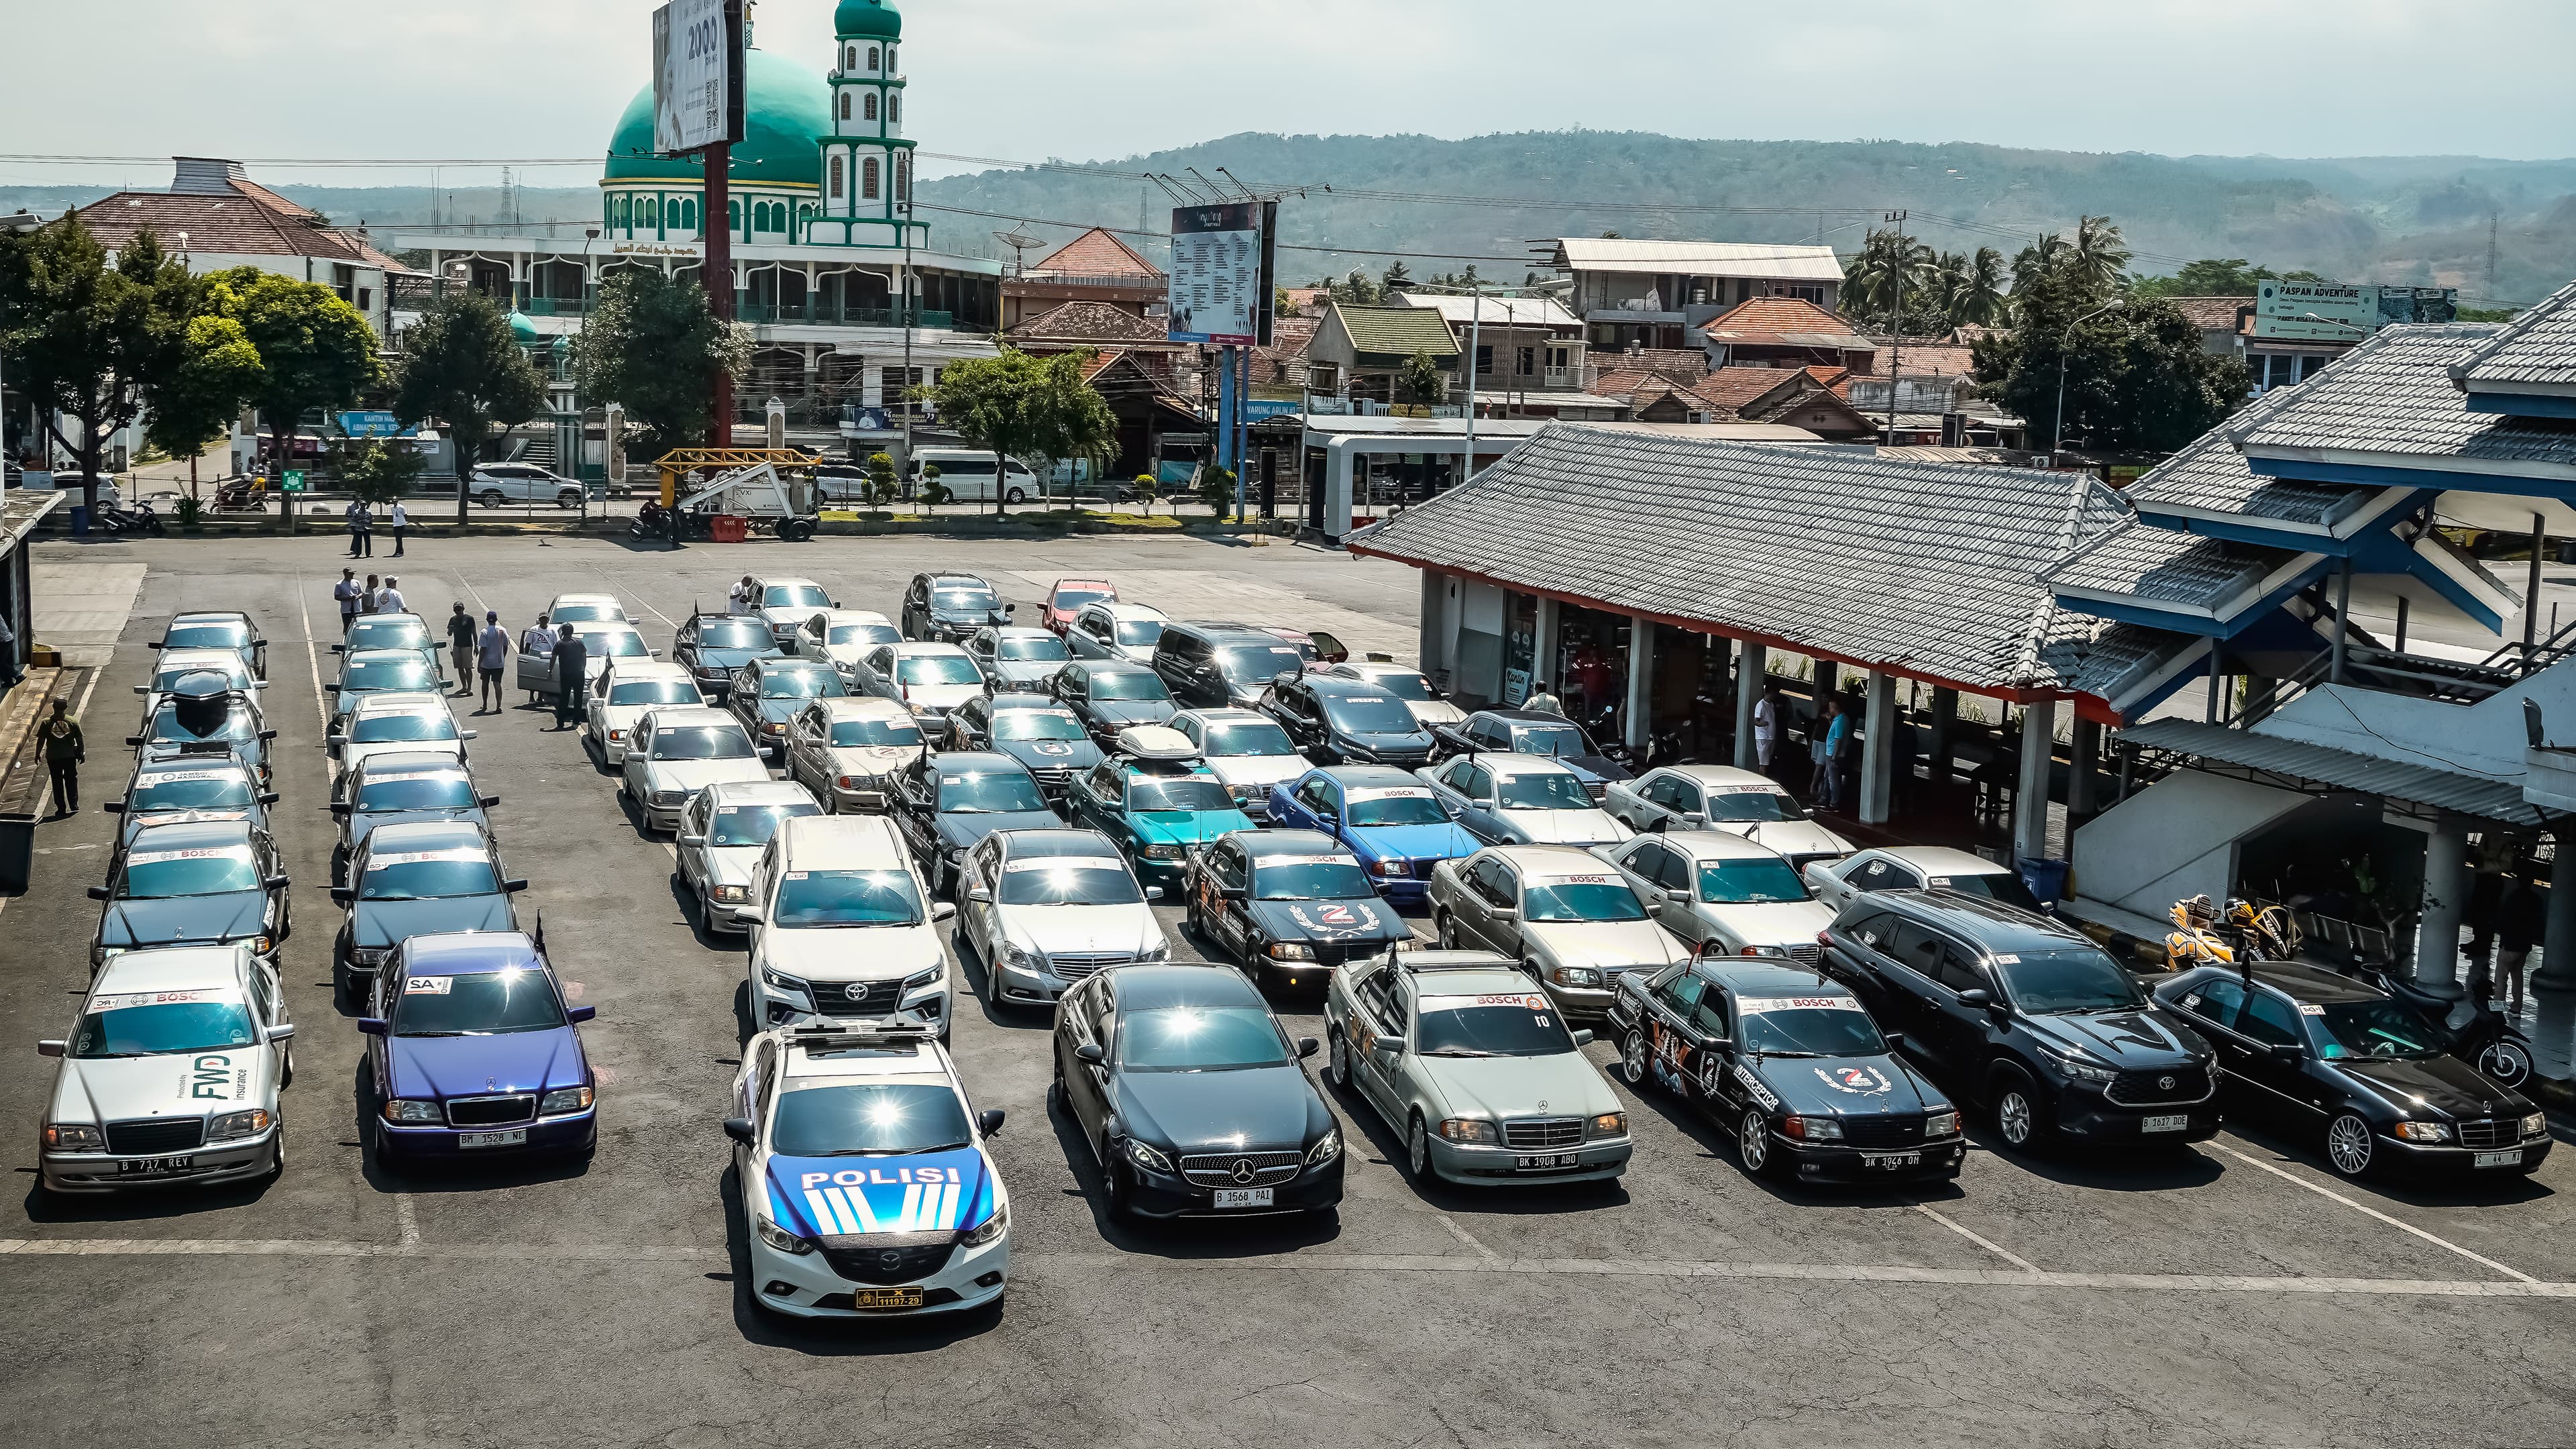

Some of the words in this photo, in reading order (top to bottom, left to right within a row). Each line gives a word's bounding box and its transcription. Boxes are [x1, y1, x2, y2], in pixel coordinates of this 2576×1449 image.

[688, 15, 717, 60] 2000
[2279, 286, 2312, 296] PASPAN
[2314, 288, 2359, 298] ADVENTURE
[2267, 918, 2282, 945] YAMAHA
[156, 993, 202, 1002] BOSC
[1476, 996, 1522, 1004] BOSCH
[1792, 999, 1836, 1007] BOSCH
[193, 1055, 230, 1099] FWD
[177, 1081, 186, 1099] Protected
[233, 1068, 247, 1100] insurance
[1735, 1064, 1780, 1109] INTERCEPTOR
[2144, 1120, 2148, 1128] B
[462, 1135, 473, 1144] BM
[482, 1134, 504, 1143] 1528
[513, 1132, 524, 1140] NL
[122, 1161, 129, 1171] B
[140, 1159, 160, 1170] 717
[168, 1157, 188, 1167] REY
[1519, 1157, 1530, 1167] BK
[1534, 1156, 1556, 1166] 1908
[1866, 1158, 1876, 1167] BK
[2477, 1155, 2482, 1165] S
[801, 1167, 962, 1189] POLISI
[1217, 1192, 1222, 1202] B
[1227, 1191, 1248, 1201] 1568
[1256, 1189, 1270, 1200] PAI
[879, 1297, 920, 1305] 11197-29
